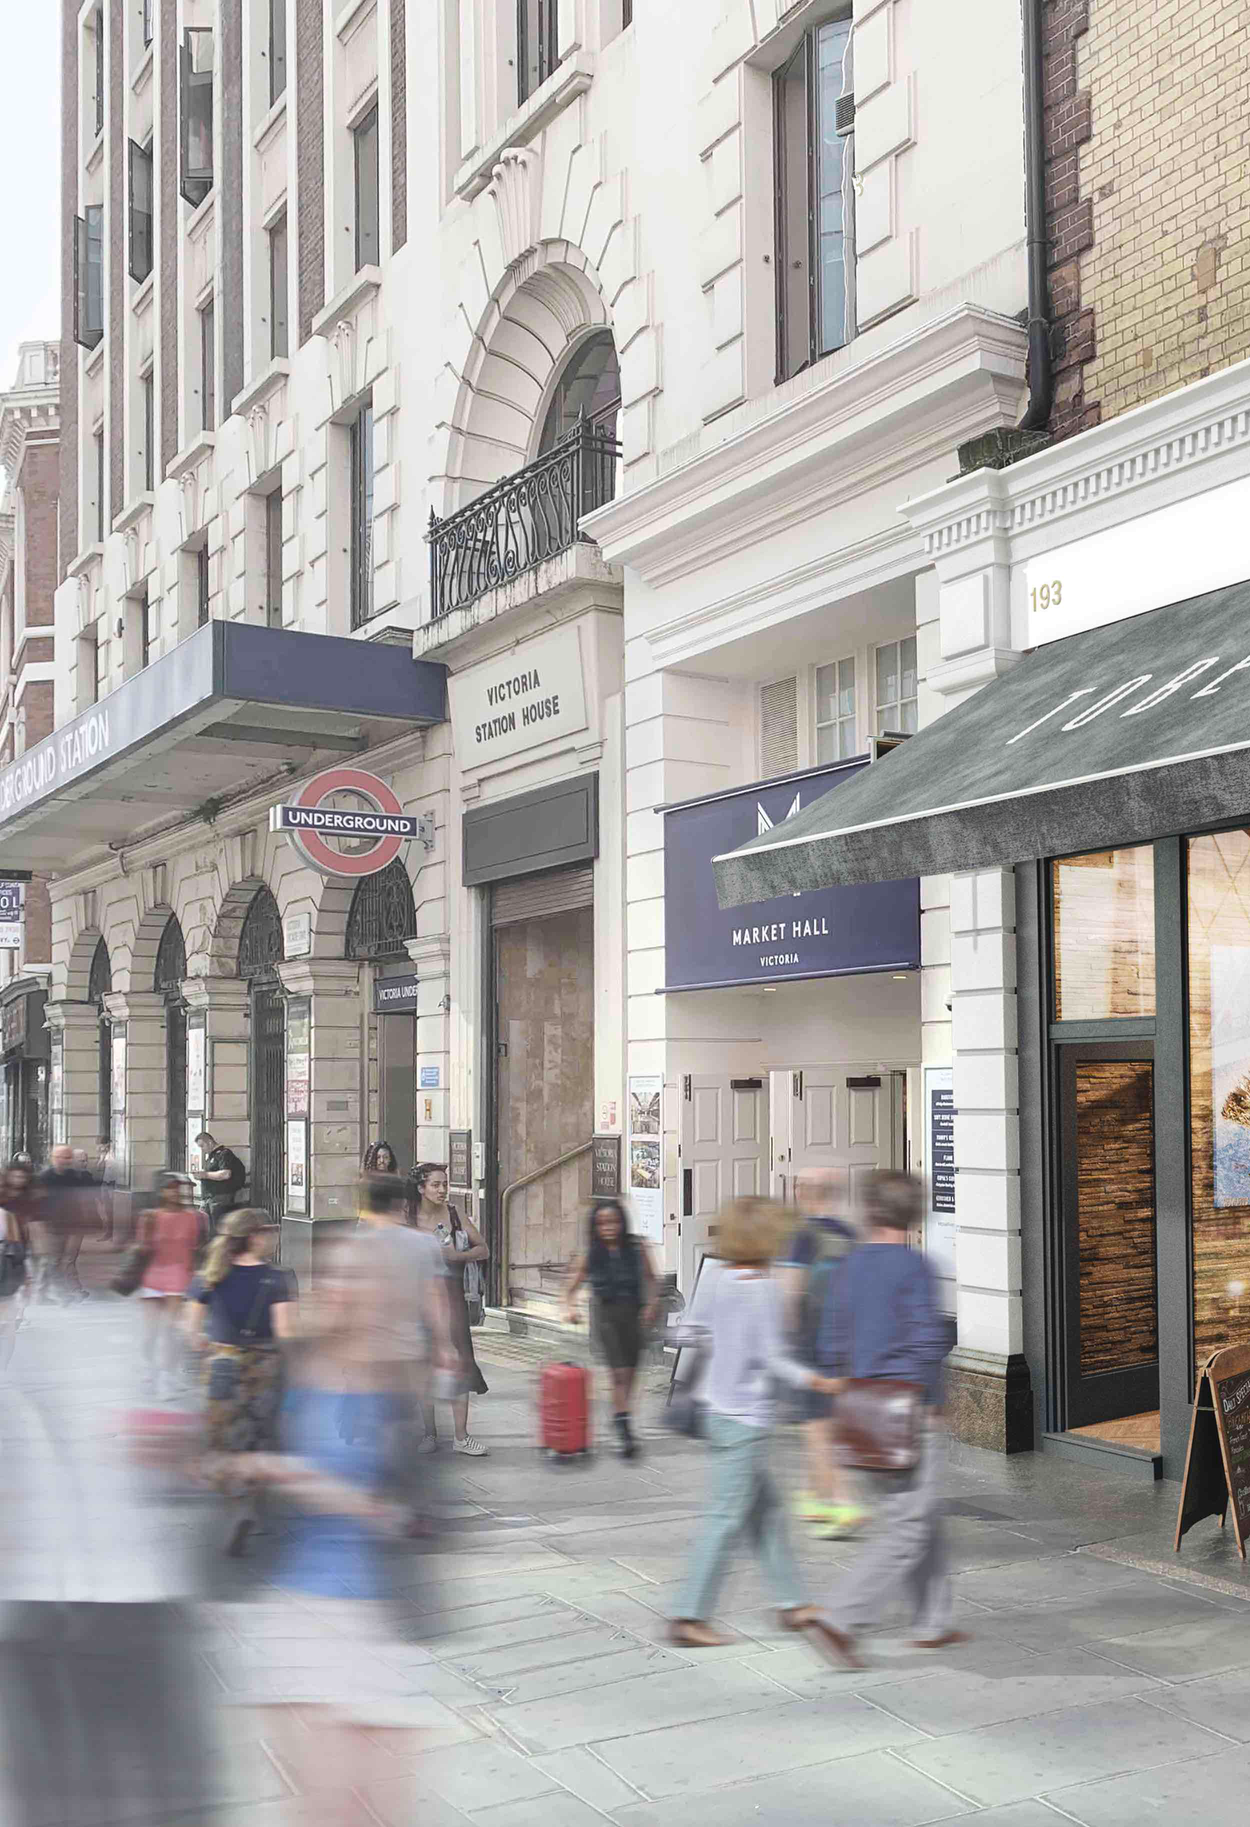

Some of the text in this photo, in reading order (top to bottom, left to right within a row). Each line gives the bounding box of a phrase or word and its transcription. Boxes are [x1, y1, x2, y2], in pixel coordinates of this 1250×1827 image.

[1030, 580, 1063, 612] 193
[487, 669, 540, 706] VICTORIA
[475, 695, 560, 743] STATION HOUSE
[60, 709, 109, 773] STATION
[288, 810, 411, 832] UNDERGROUND
[732, 917, 829, 946] MARKET HALL
[760, 953, 799, 967] VICTORIA
